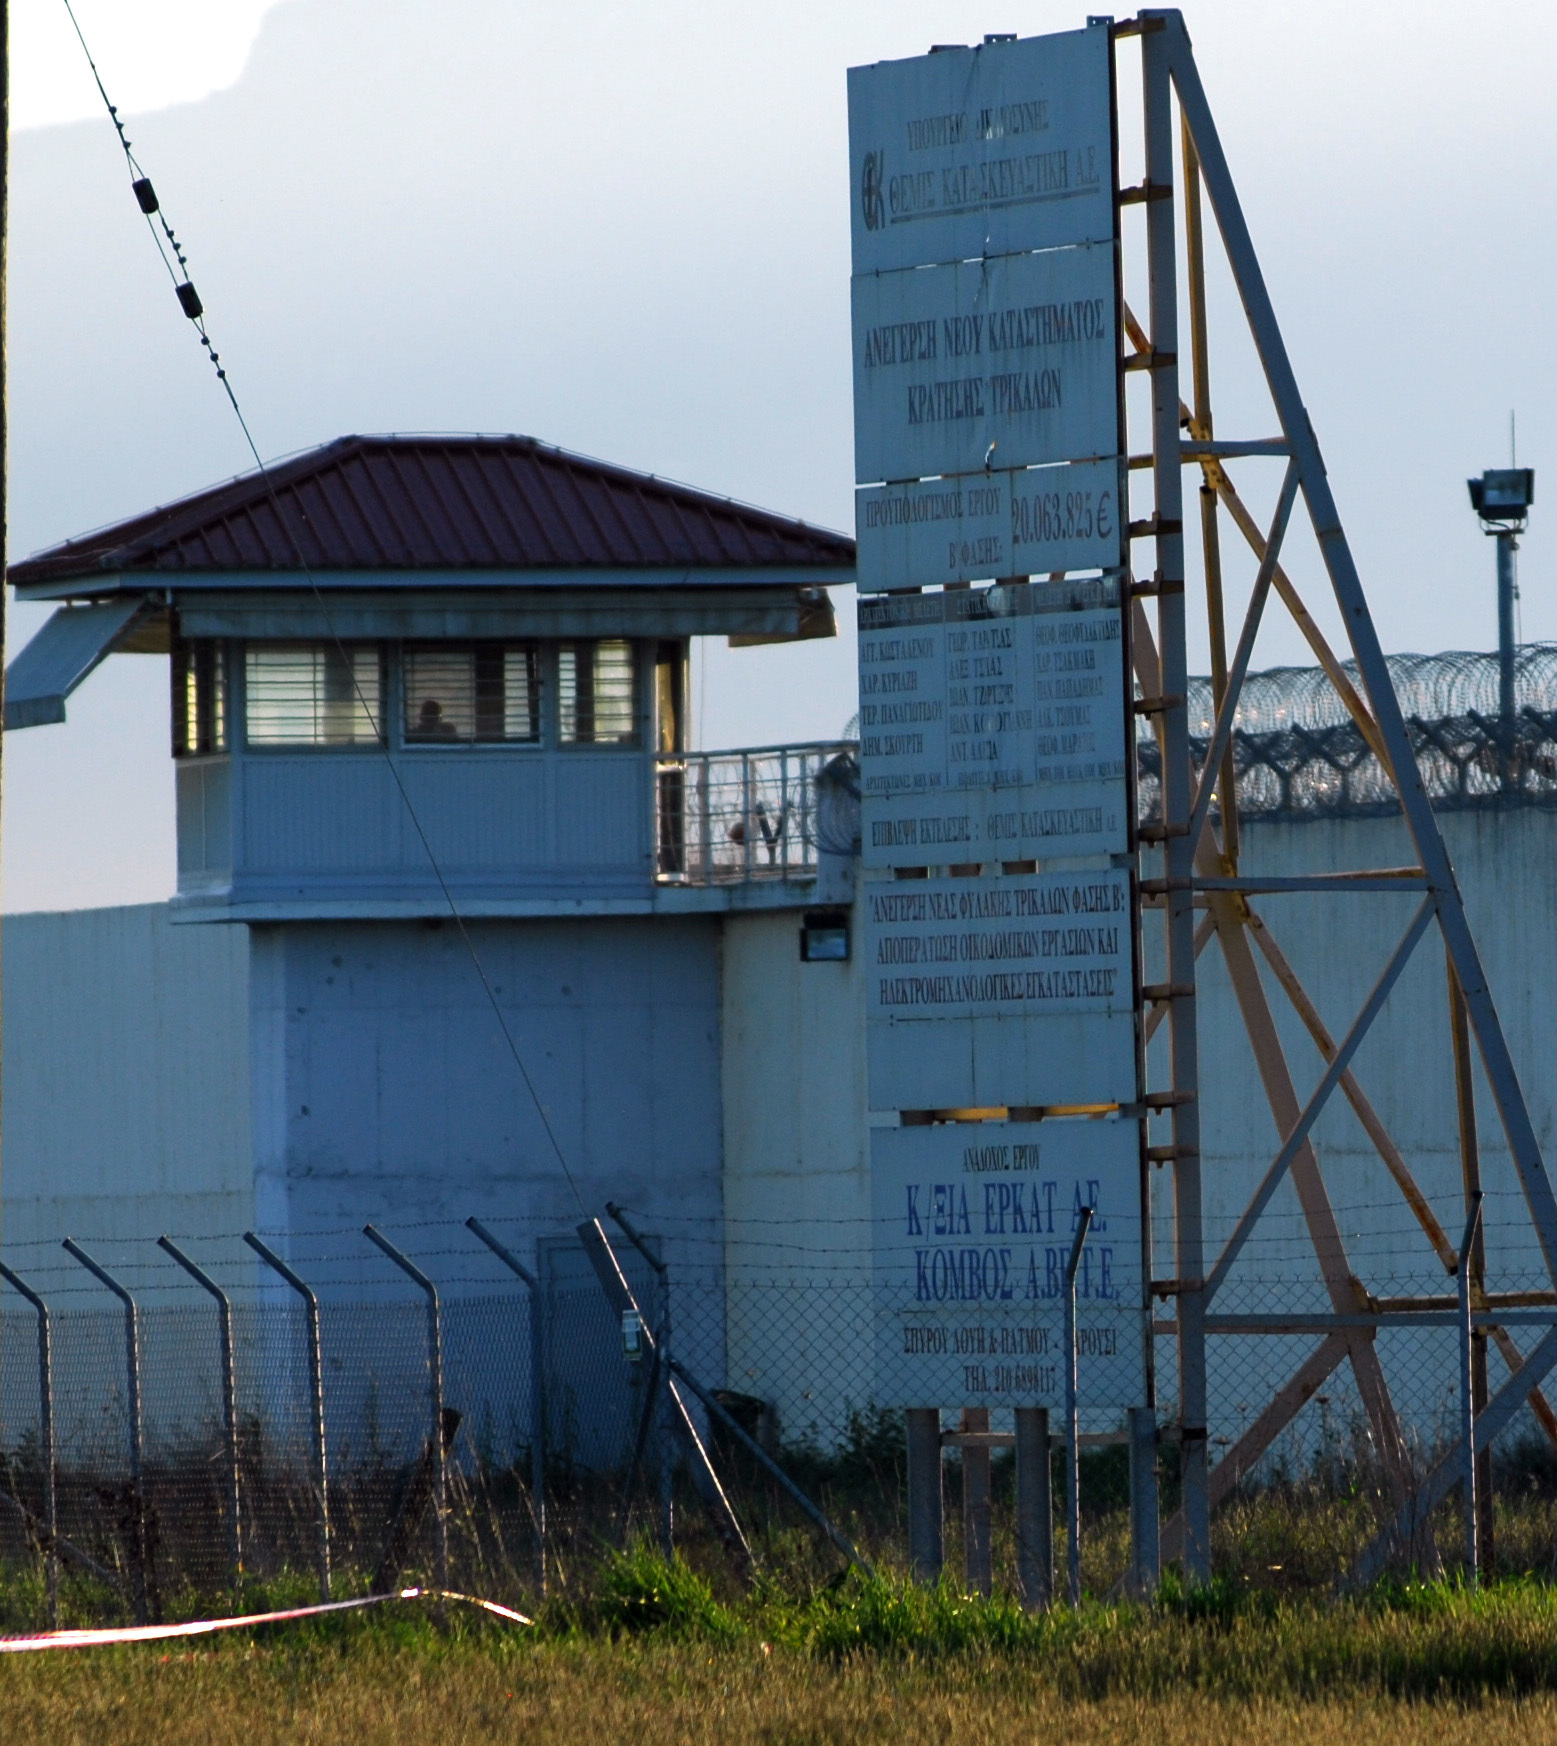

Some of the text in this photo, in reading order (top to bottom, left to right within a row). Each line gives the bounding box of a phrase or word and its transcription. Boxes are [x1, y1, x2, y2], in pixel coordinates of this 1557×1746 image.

[906, 111, 968, 151] ΥΠΟΥΡΓΕΙΟ
[864, 298, 1105, 368] ΑΝΕΓΕΡΣΗ ΝΕΟΥ ΚΑΤΑΣΤΗΜΑΤΟΣ
[907, 368, 1062, 425] ΚΡΑΤΗΣΗΣ ΤΡΙΚΑΛΩΝ
[968, 487, 1001, 517] ΕΡΓΟΥ
[928, 892, 957, 920] ΝΕΑΣ
[959, 890, 1012, 919] ΦΥΛΑΚΗΣ
[1014, 886, 1070, 917] ΤΡΙΚΑΛΩΝ
[1072, 885, 1110, 914] ΦΑΣΗΣ
[877, 927, 1118, 964] ΑΠΟΠΕΡΑΤΩΣΗ ΟΙΚΟΔΟΜΙΚΩΝ ΕΡΓΑΣΙΩΝ ΚΑΙ
[880, 972, 1024, 1005] ΗΛΕΚΤΡΟΜΗΧΑΝΟΛΟΓΙΚΕΣ
[963, 1144, 1041, 1173] ΑΝΑΔΟΧΟΣ ΕΡΓΟΥ
[906, 1183, 971, 1242] Κ/ΞΙΑ
[983, 1181, 1058, 1234] ΕΡΚΑΤ
[915, 1248, 1013, 1302] ΚΟΜΒΟΣ
[904, 1327, 948, 1354] ΣΠΥΡΟΥ
[952, 1327, 985, 1354] ΛΟΥΗ
[989, 1328, 998, 1354] &
[1001, 1327, 1050, 1354] ΠΑΤΜΟΥ
[963, 1366, 990, 1393] ΤΗΛ.
